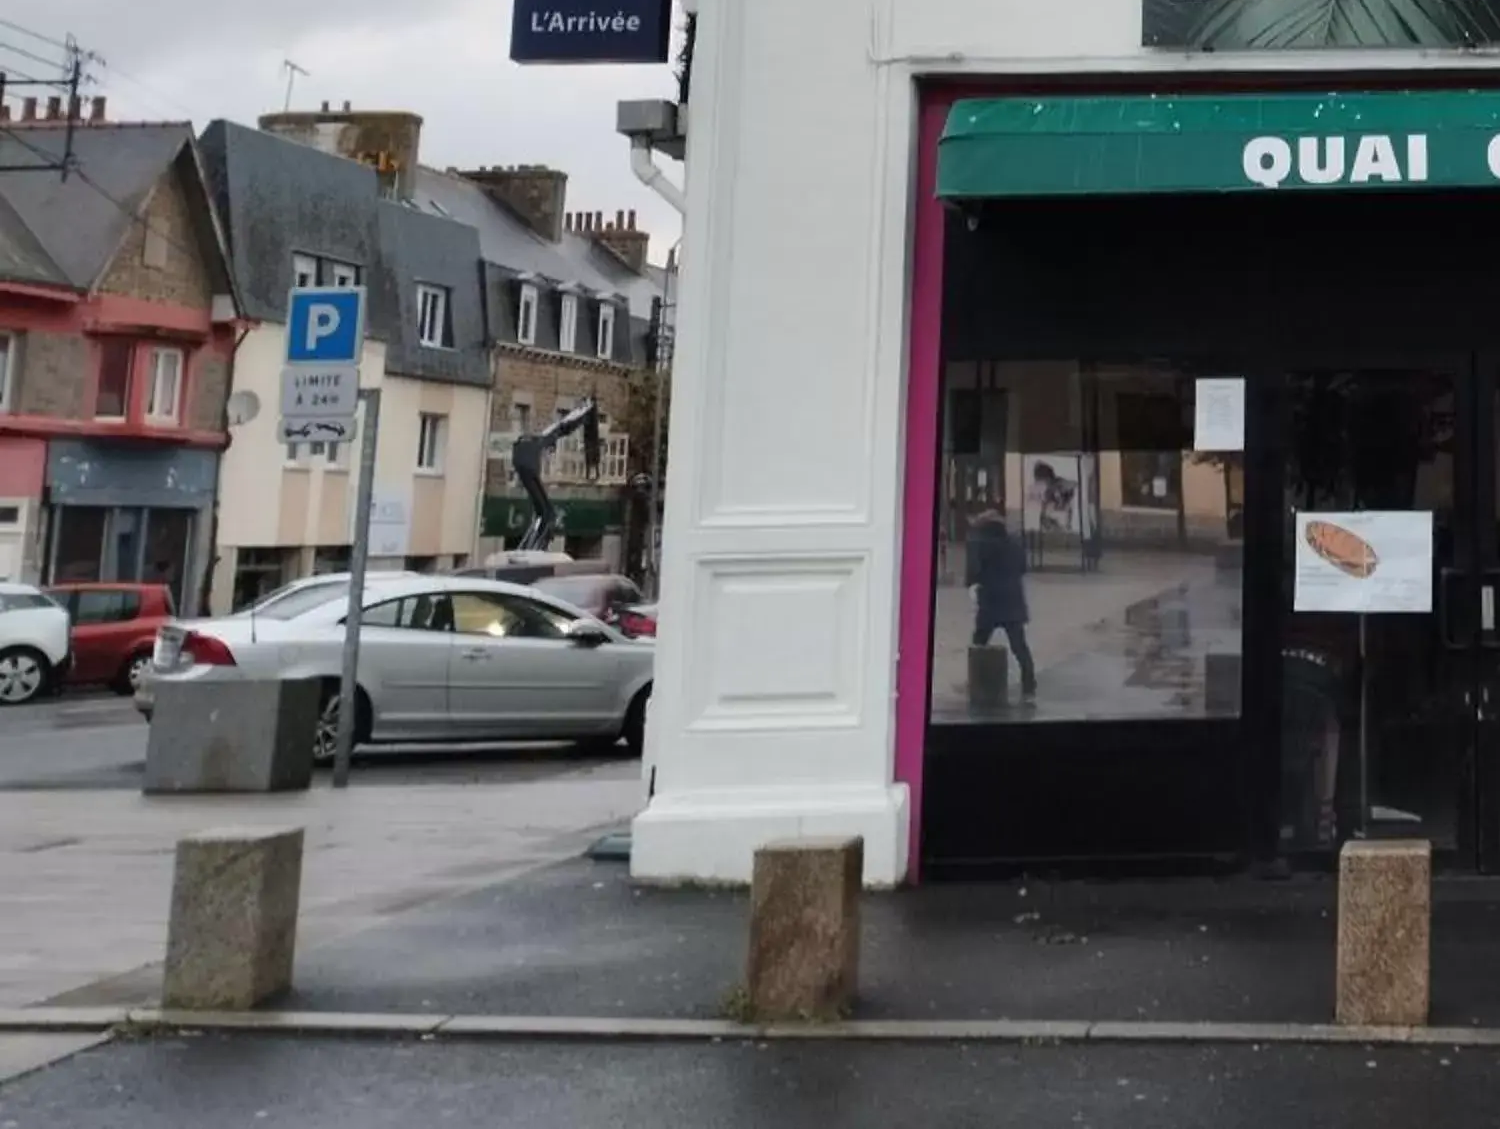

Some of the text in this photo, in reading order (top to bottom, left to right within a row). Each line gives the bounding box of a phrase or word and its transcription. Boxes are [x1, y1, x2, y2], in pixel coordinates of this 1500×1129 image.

[530, 11, 641, 32] L'Arrivée
[1242, 135, 1429, 188] QUAI
[306, 304, 341, 351] P
